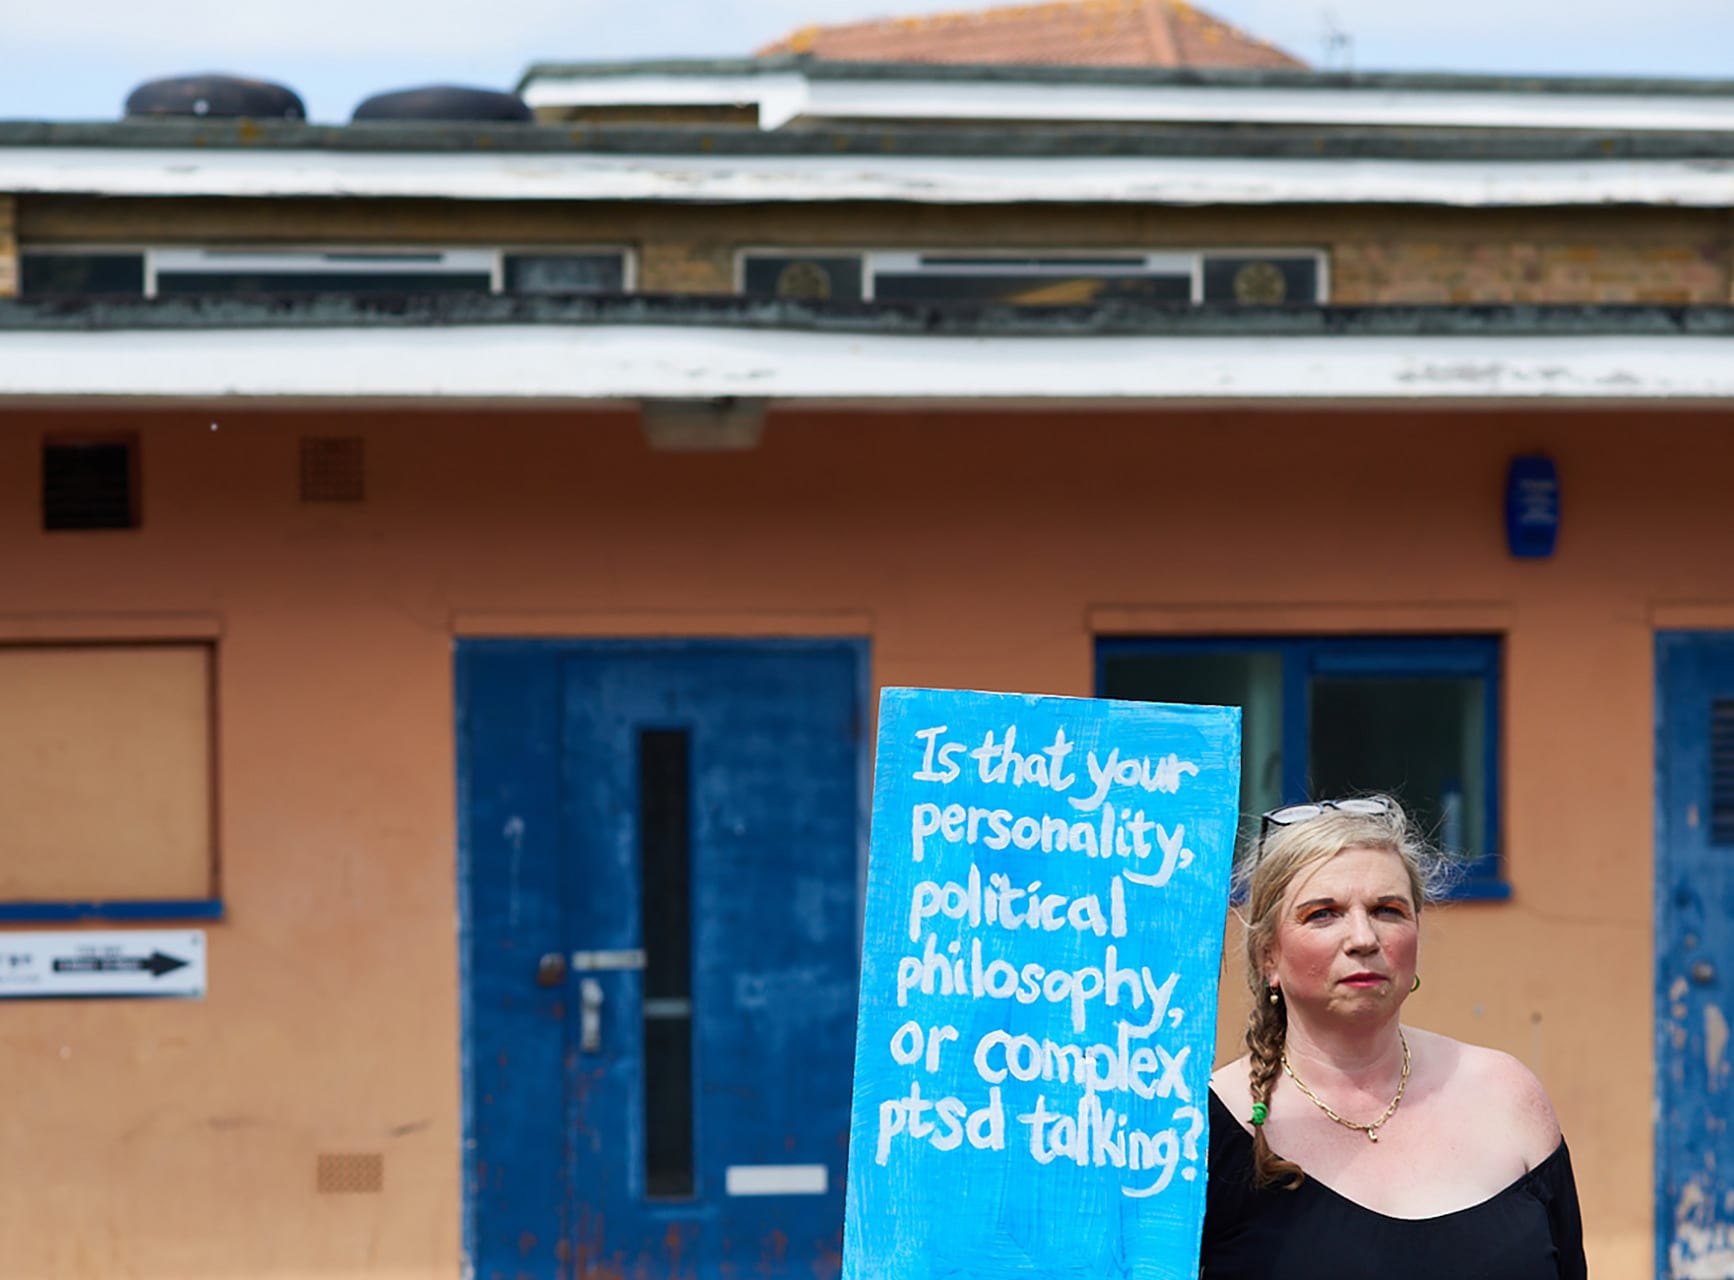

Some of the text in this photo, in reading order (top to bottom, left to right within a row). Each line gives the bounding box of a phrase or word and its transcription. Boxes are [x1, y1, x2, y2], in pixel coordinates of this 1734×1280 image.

[912, 725, 1200, 812] Is that your
[912, 802, 1194, 888] personality,
[910, 864, 1127, 942] political
[897, 933, 1184, 1038] philosophy,
[890, 1020, 1192, 1101] or complex
[875, 1081, 1204, 1198] ptsd talking?
